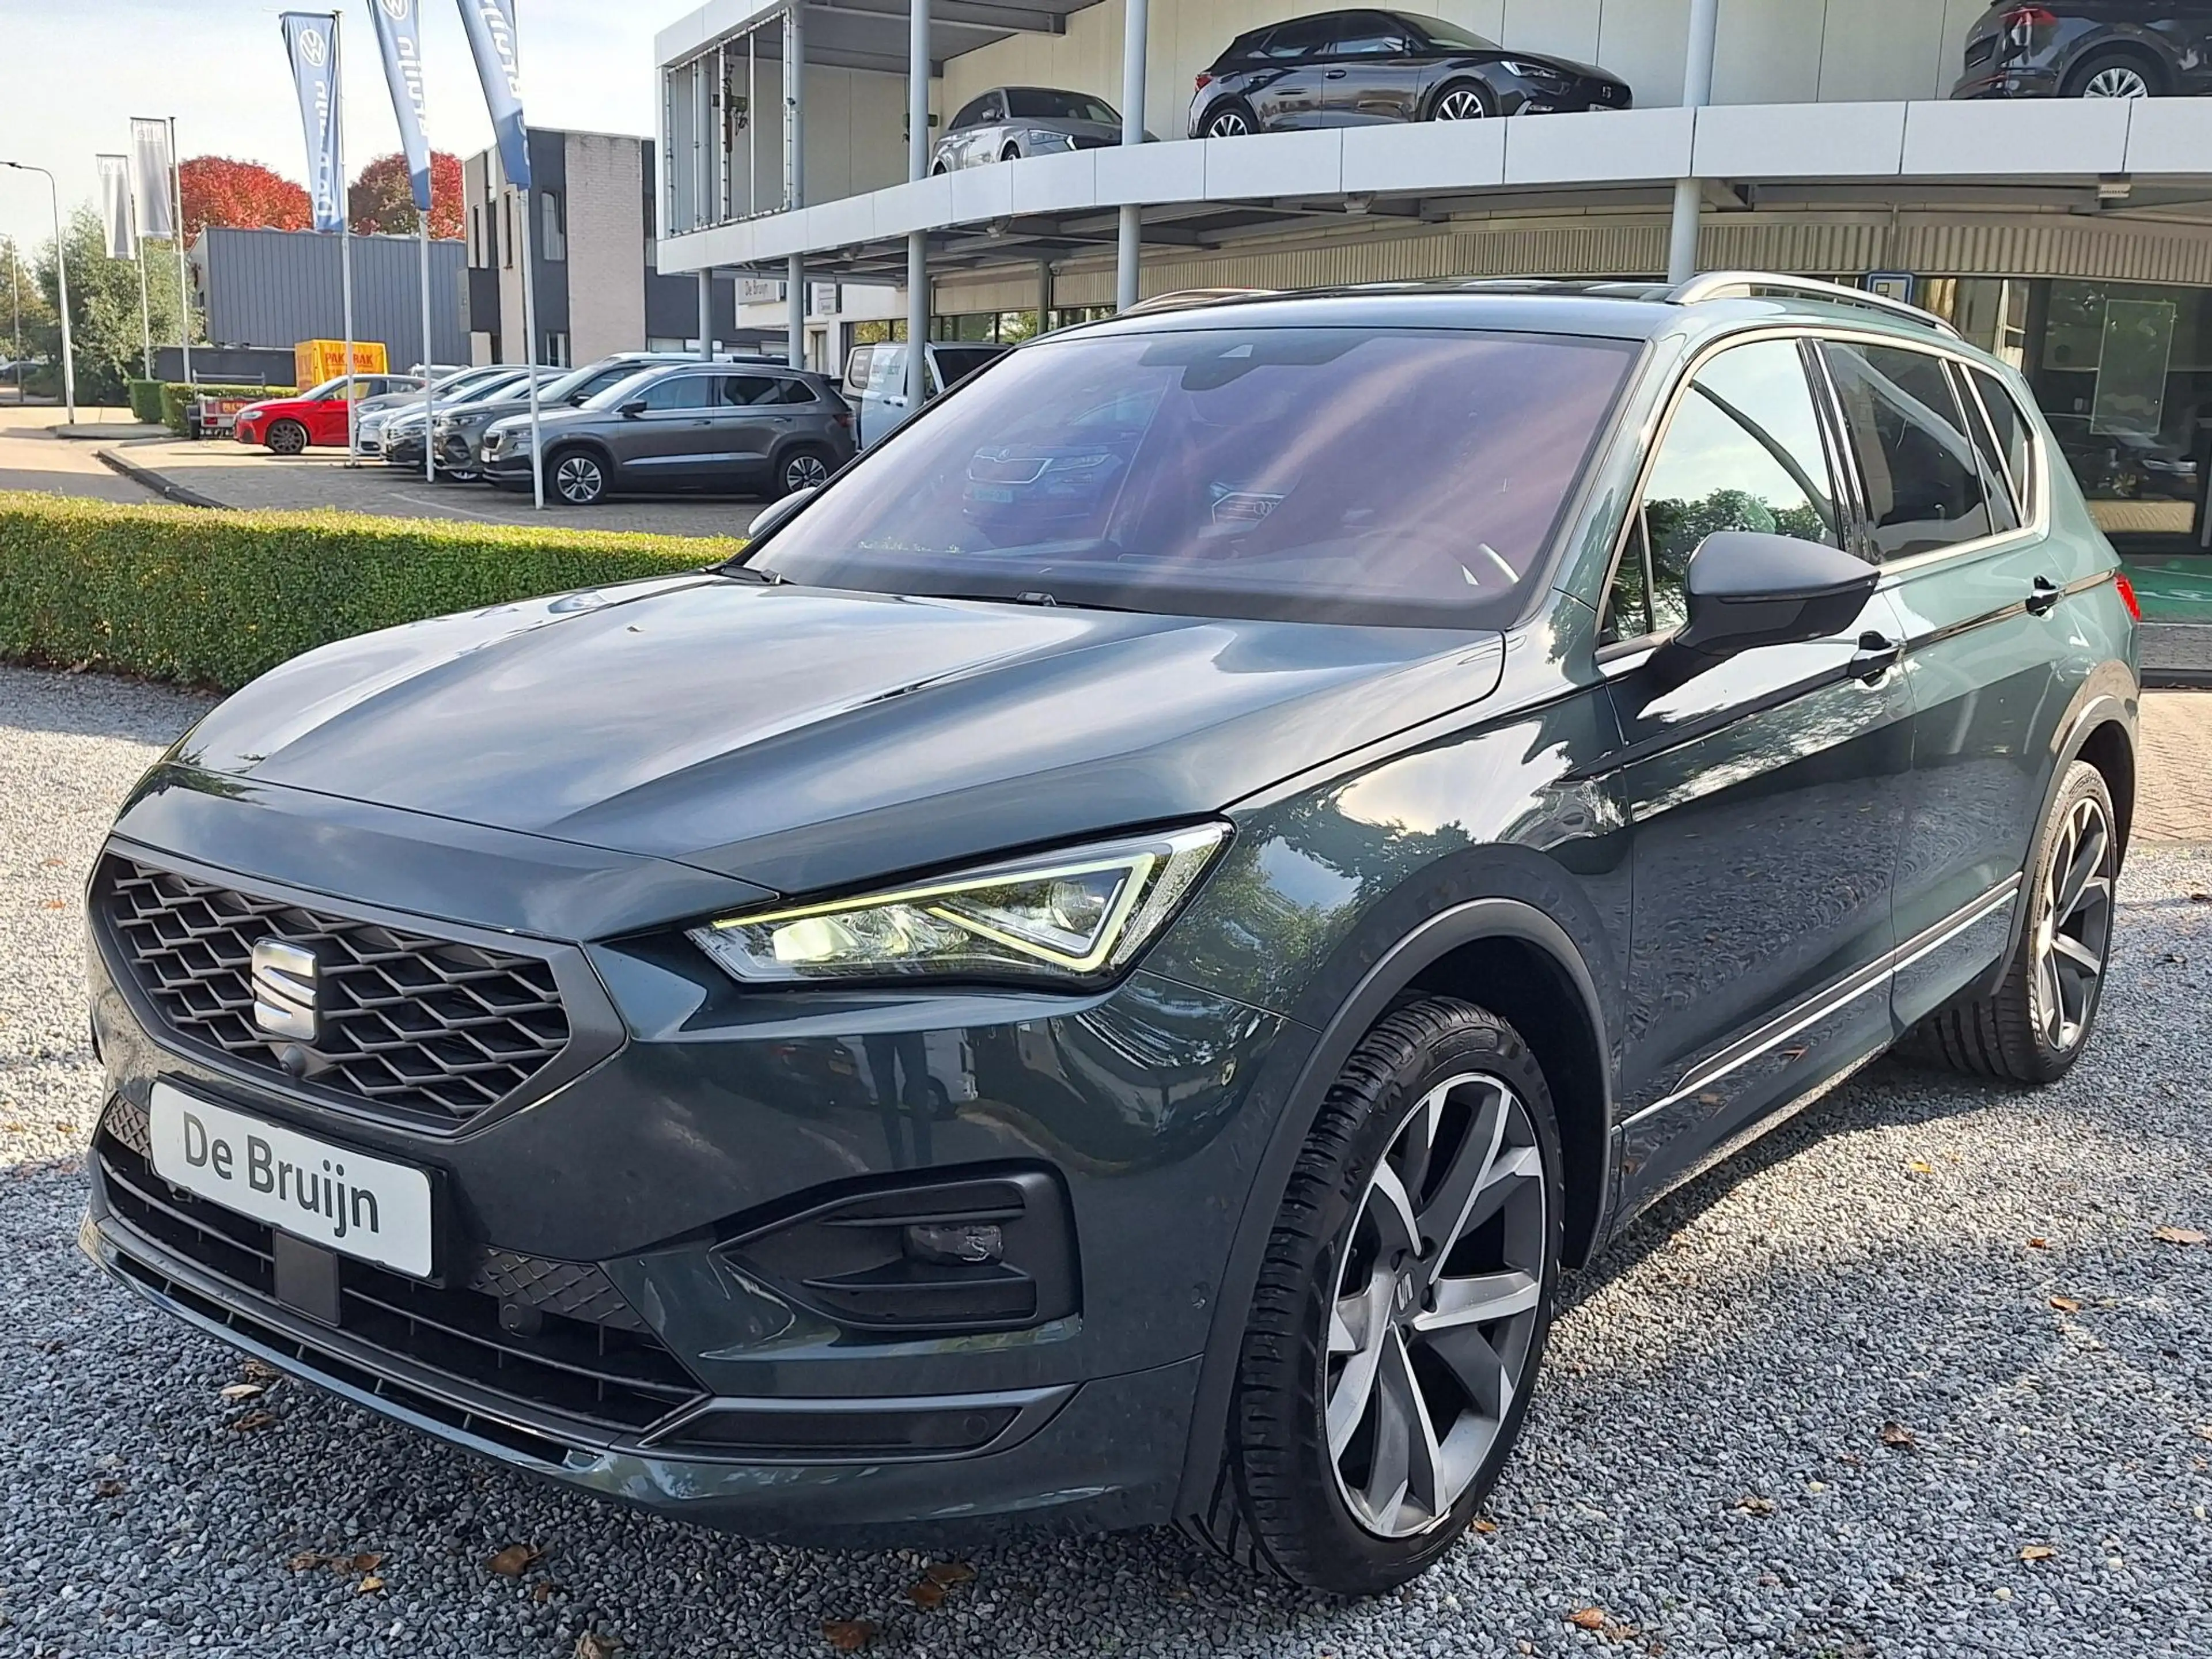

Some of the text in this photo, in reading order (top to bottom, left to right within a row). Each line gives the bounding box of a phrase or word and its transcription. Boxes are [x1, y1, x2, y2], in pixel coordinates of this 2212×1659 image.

[325, 352, 345, 363] PAK
[183, 1111, 380, 1237] De Bruijn
